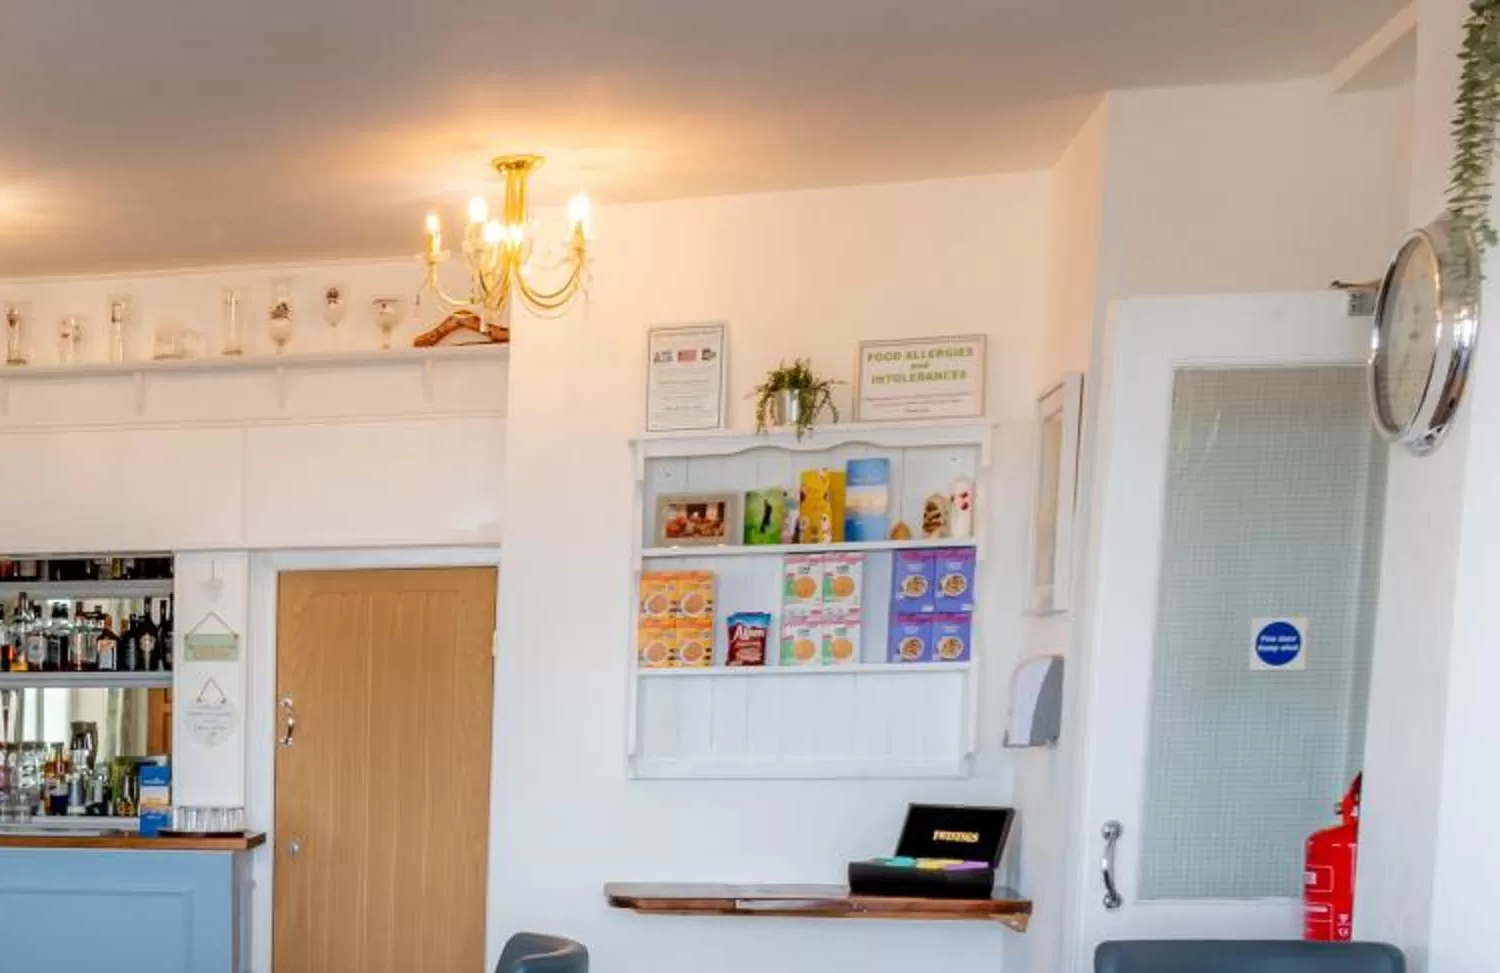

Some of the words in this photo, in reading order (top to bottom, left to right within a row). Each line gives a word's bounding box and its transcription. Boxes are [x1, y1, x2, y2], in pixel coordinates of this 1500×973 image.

[867, 351, 901, 362] FOOD
[906, 347, 973, 360] ALLERGIES
[871, 370, 966, 384] INTOLERANCES
